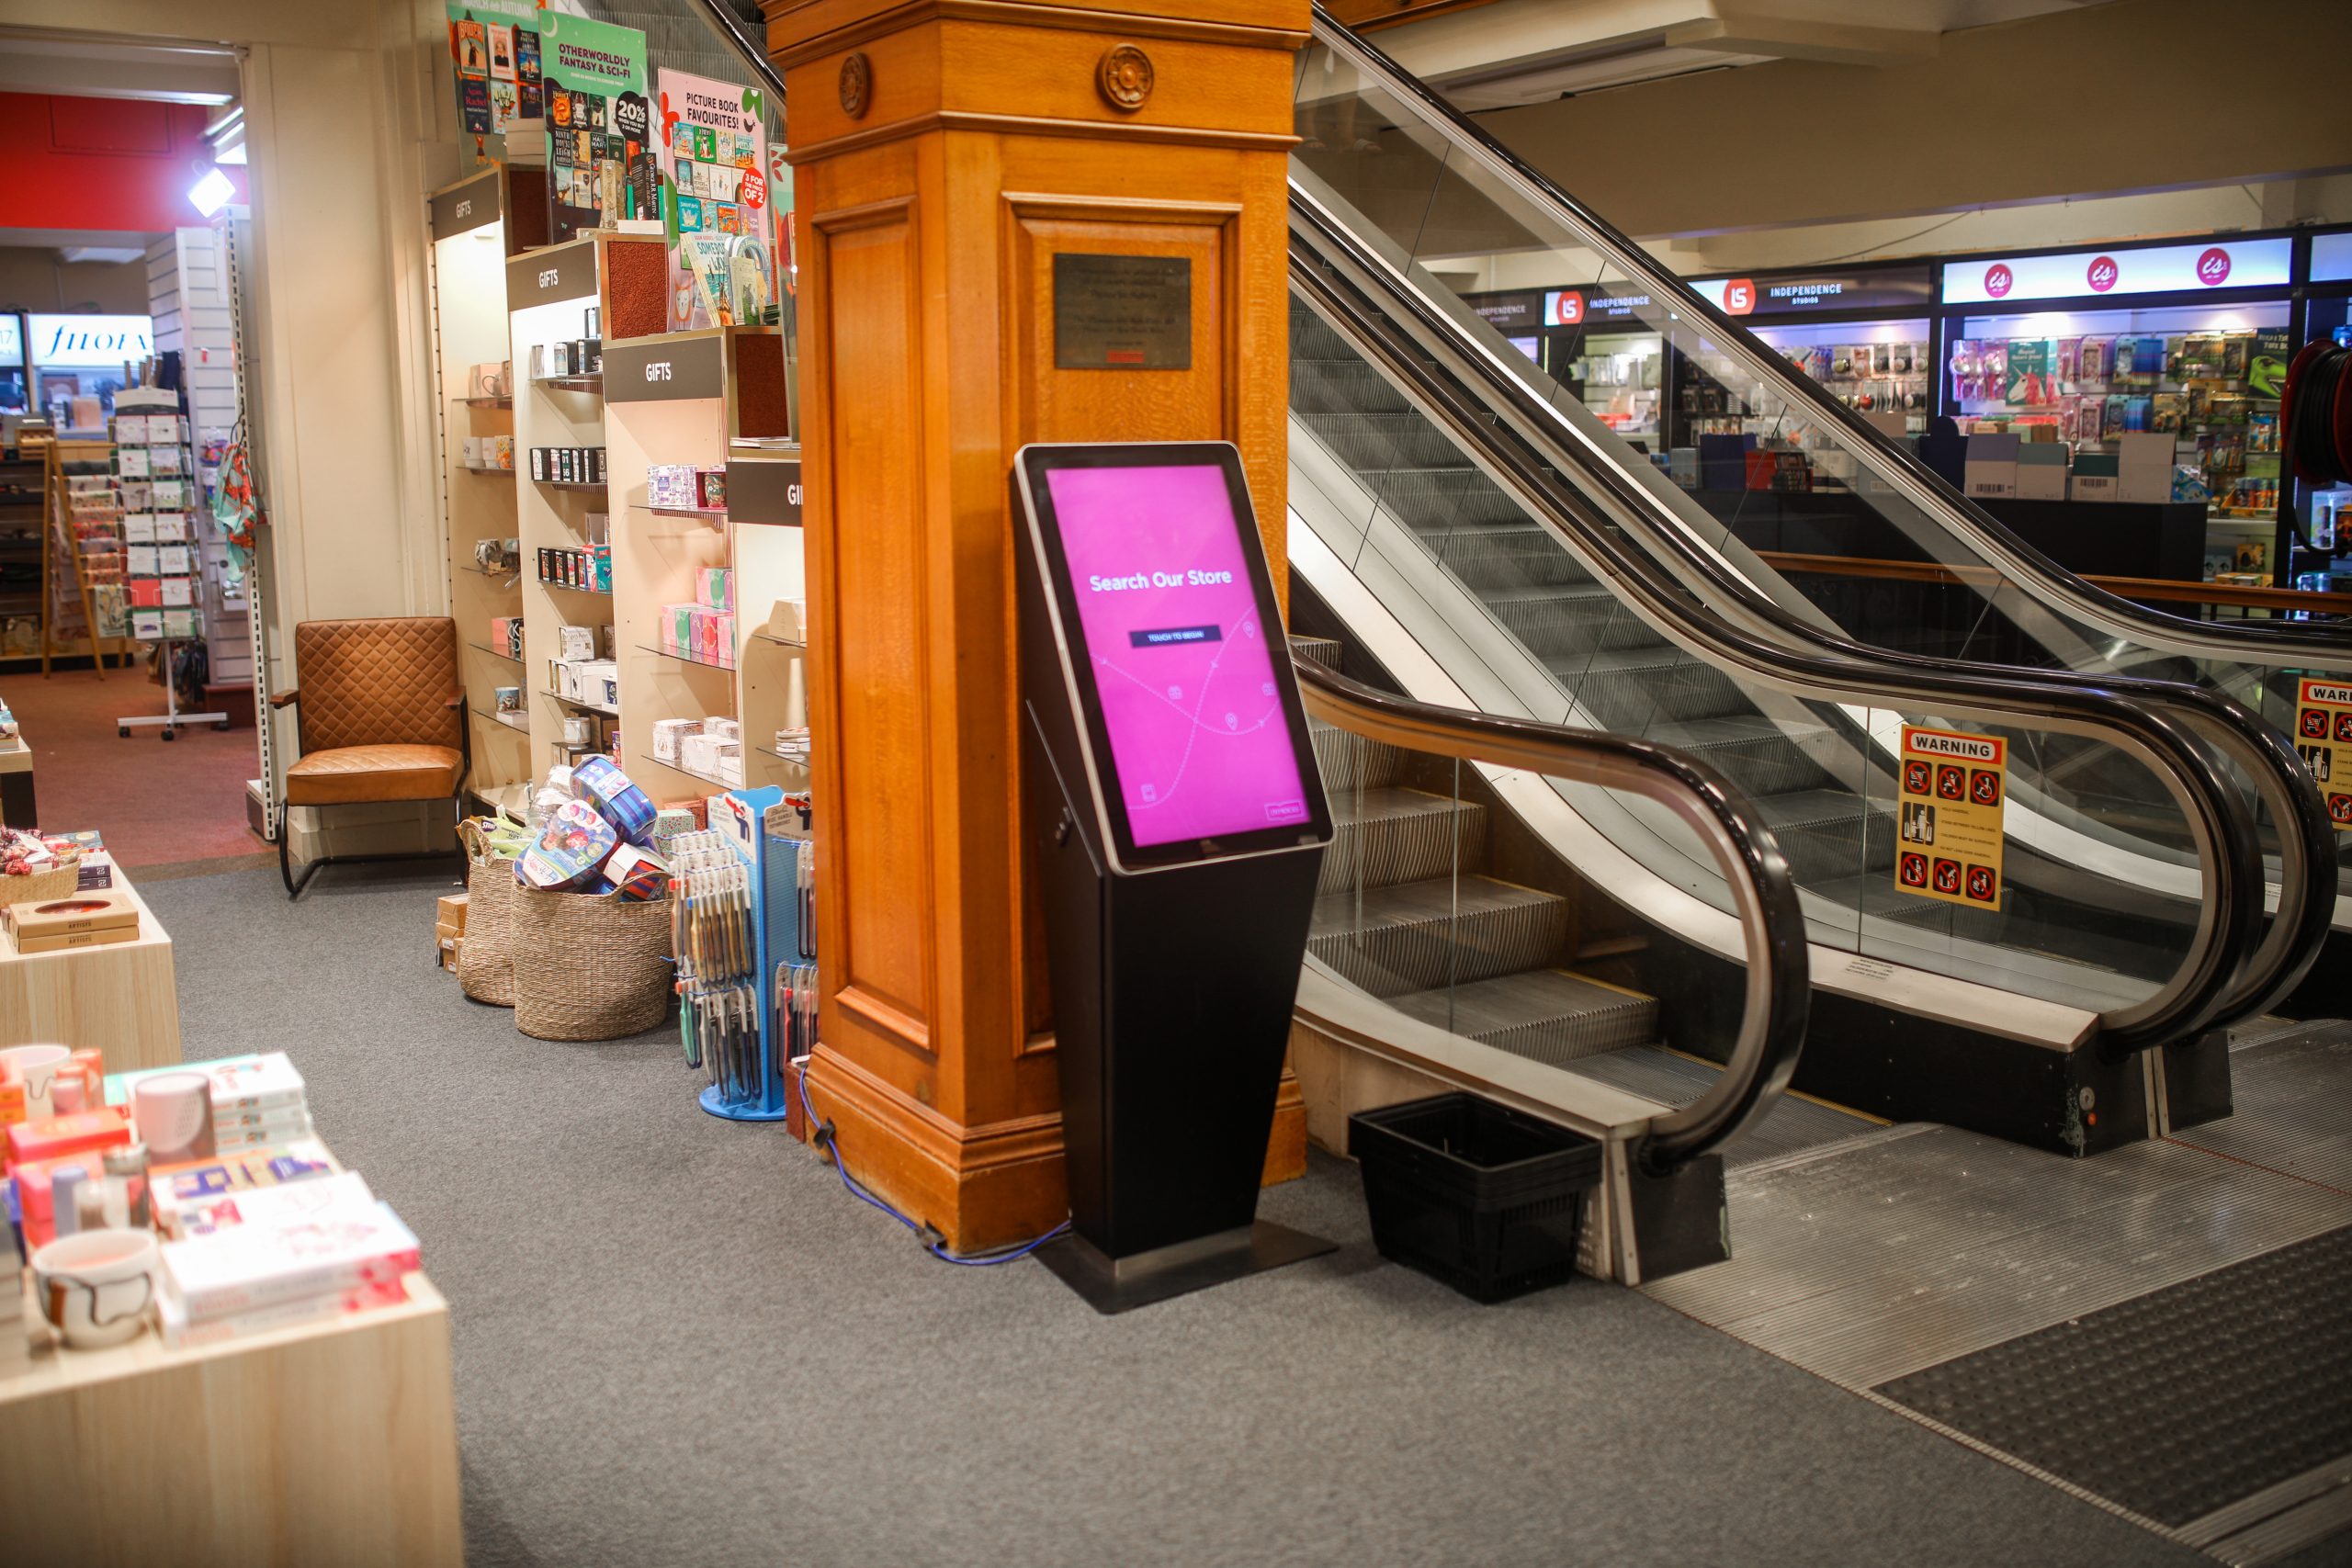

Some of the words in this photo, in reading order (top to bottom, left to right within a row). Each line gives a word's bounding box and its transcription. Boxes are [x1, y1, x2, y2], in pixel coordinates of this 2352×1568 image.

[559, 43, 630, 66] OTHERWORLDLY
[560, 56, 596, 72] FANTASY
[598, 65, 605, 73] &
[606, 66, 630, 78] SCI-FI
[618, 99, 646, 118] 20%
[686, 93, 717, 109] PICTURE
[718, 100, 739, 113] BOOK
[618, 117, 629, 125] WHEN
[687, 107, 739, 130] FAVOURITES!
[751, 175, 764, 186] FOR
[744, 187, 757, 201] OF
[757, 192, 764, 204] 2
[456, 200, 471, 219] GIFTS
[538, 268, 559, 288] GIFTS
[1770, 283, 1842, 298] INDEPENDENCE
[1476, 304, 1526, 316] NDEPENDENCE
[646, 362, 672, 381] GIFTS
[787, 484, 803, 505] GI
[1090, 572, 1150, 592] Search
[1152, 571, 1184, 588] Our
[1187, 570, 1233, 585] Store
[1148, 632, 1172, 642] TOUCH
[1916, 736, 1990, 757] WARNING
[68, 921, 92, 930] ARTISTS
[68, 936, 92, 944] ARTISTS
